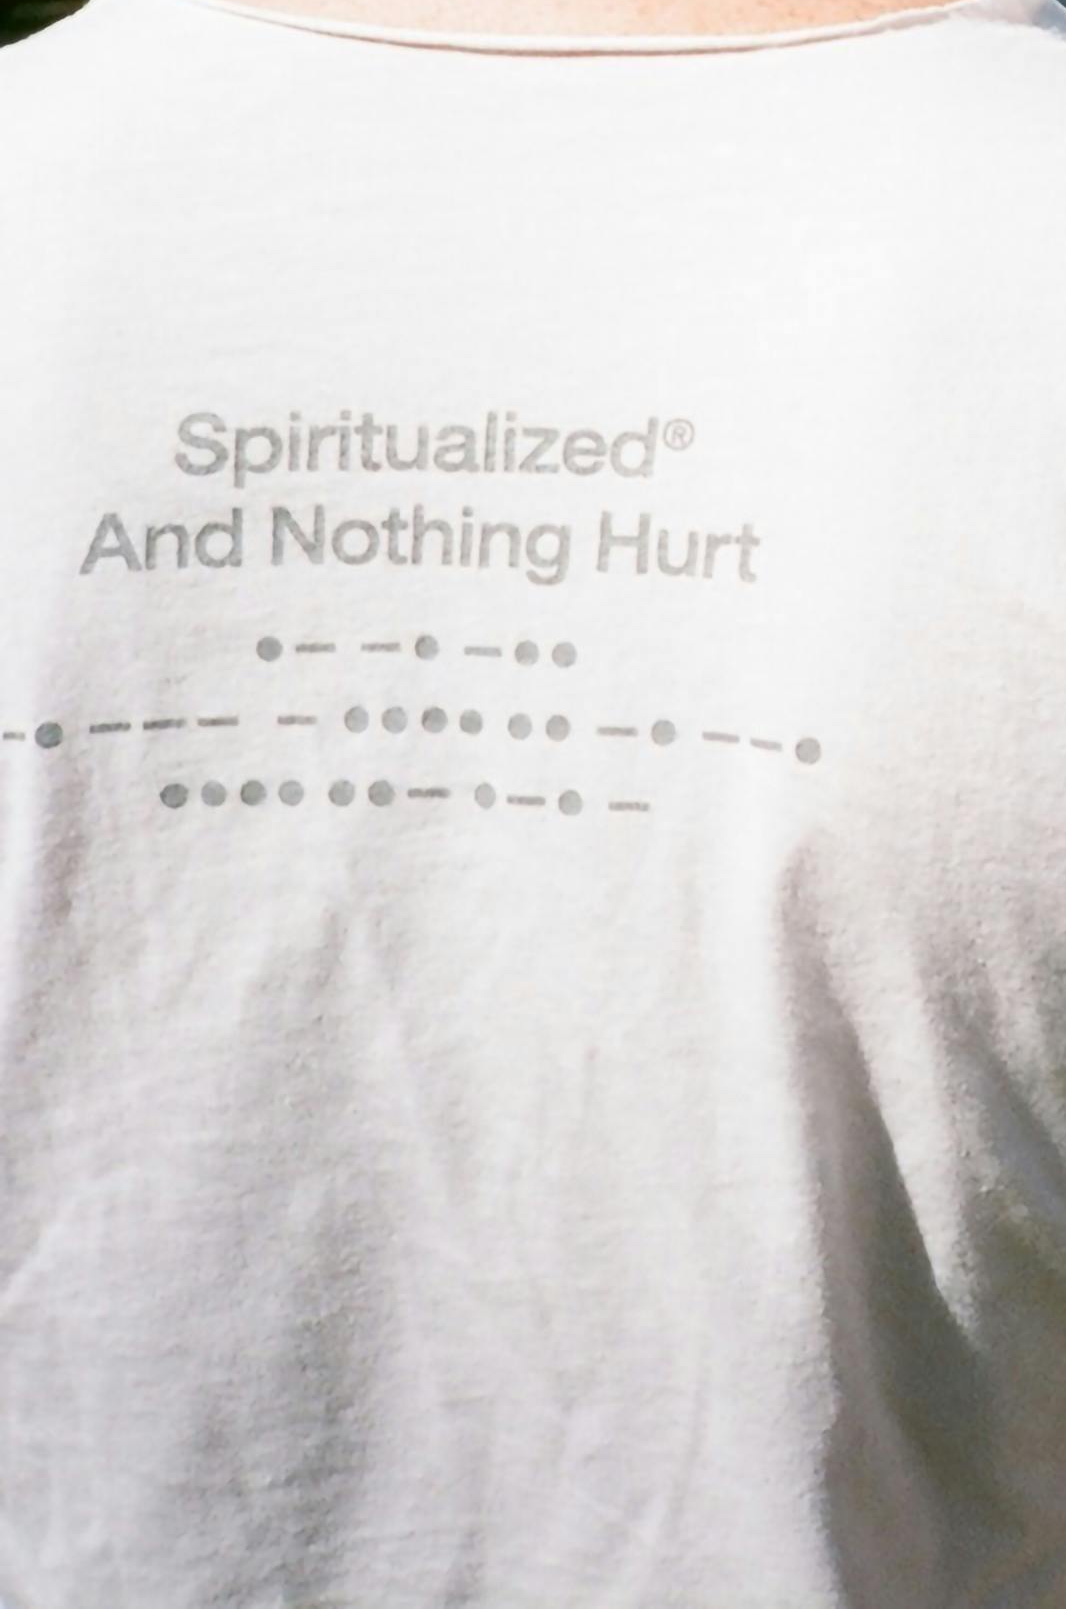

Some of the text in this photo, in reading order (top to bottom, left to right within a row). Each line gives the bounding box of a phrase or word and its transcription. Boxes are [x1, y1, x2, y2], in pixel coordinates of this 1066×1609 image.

[79, 504, 762, 586] And Nothing Hurt
